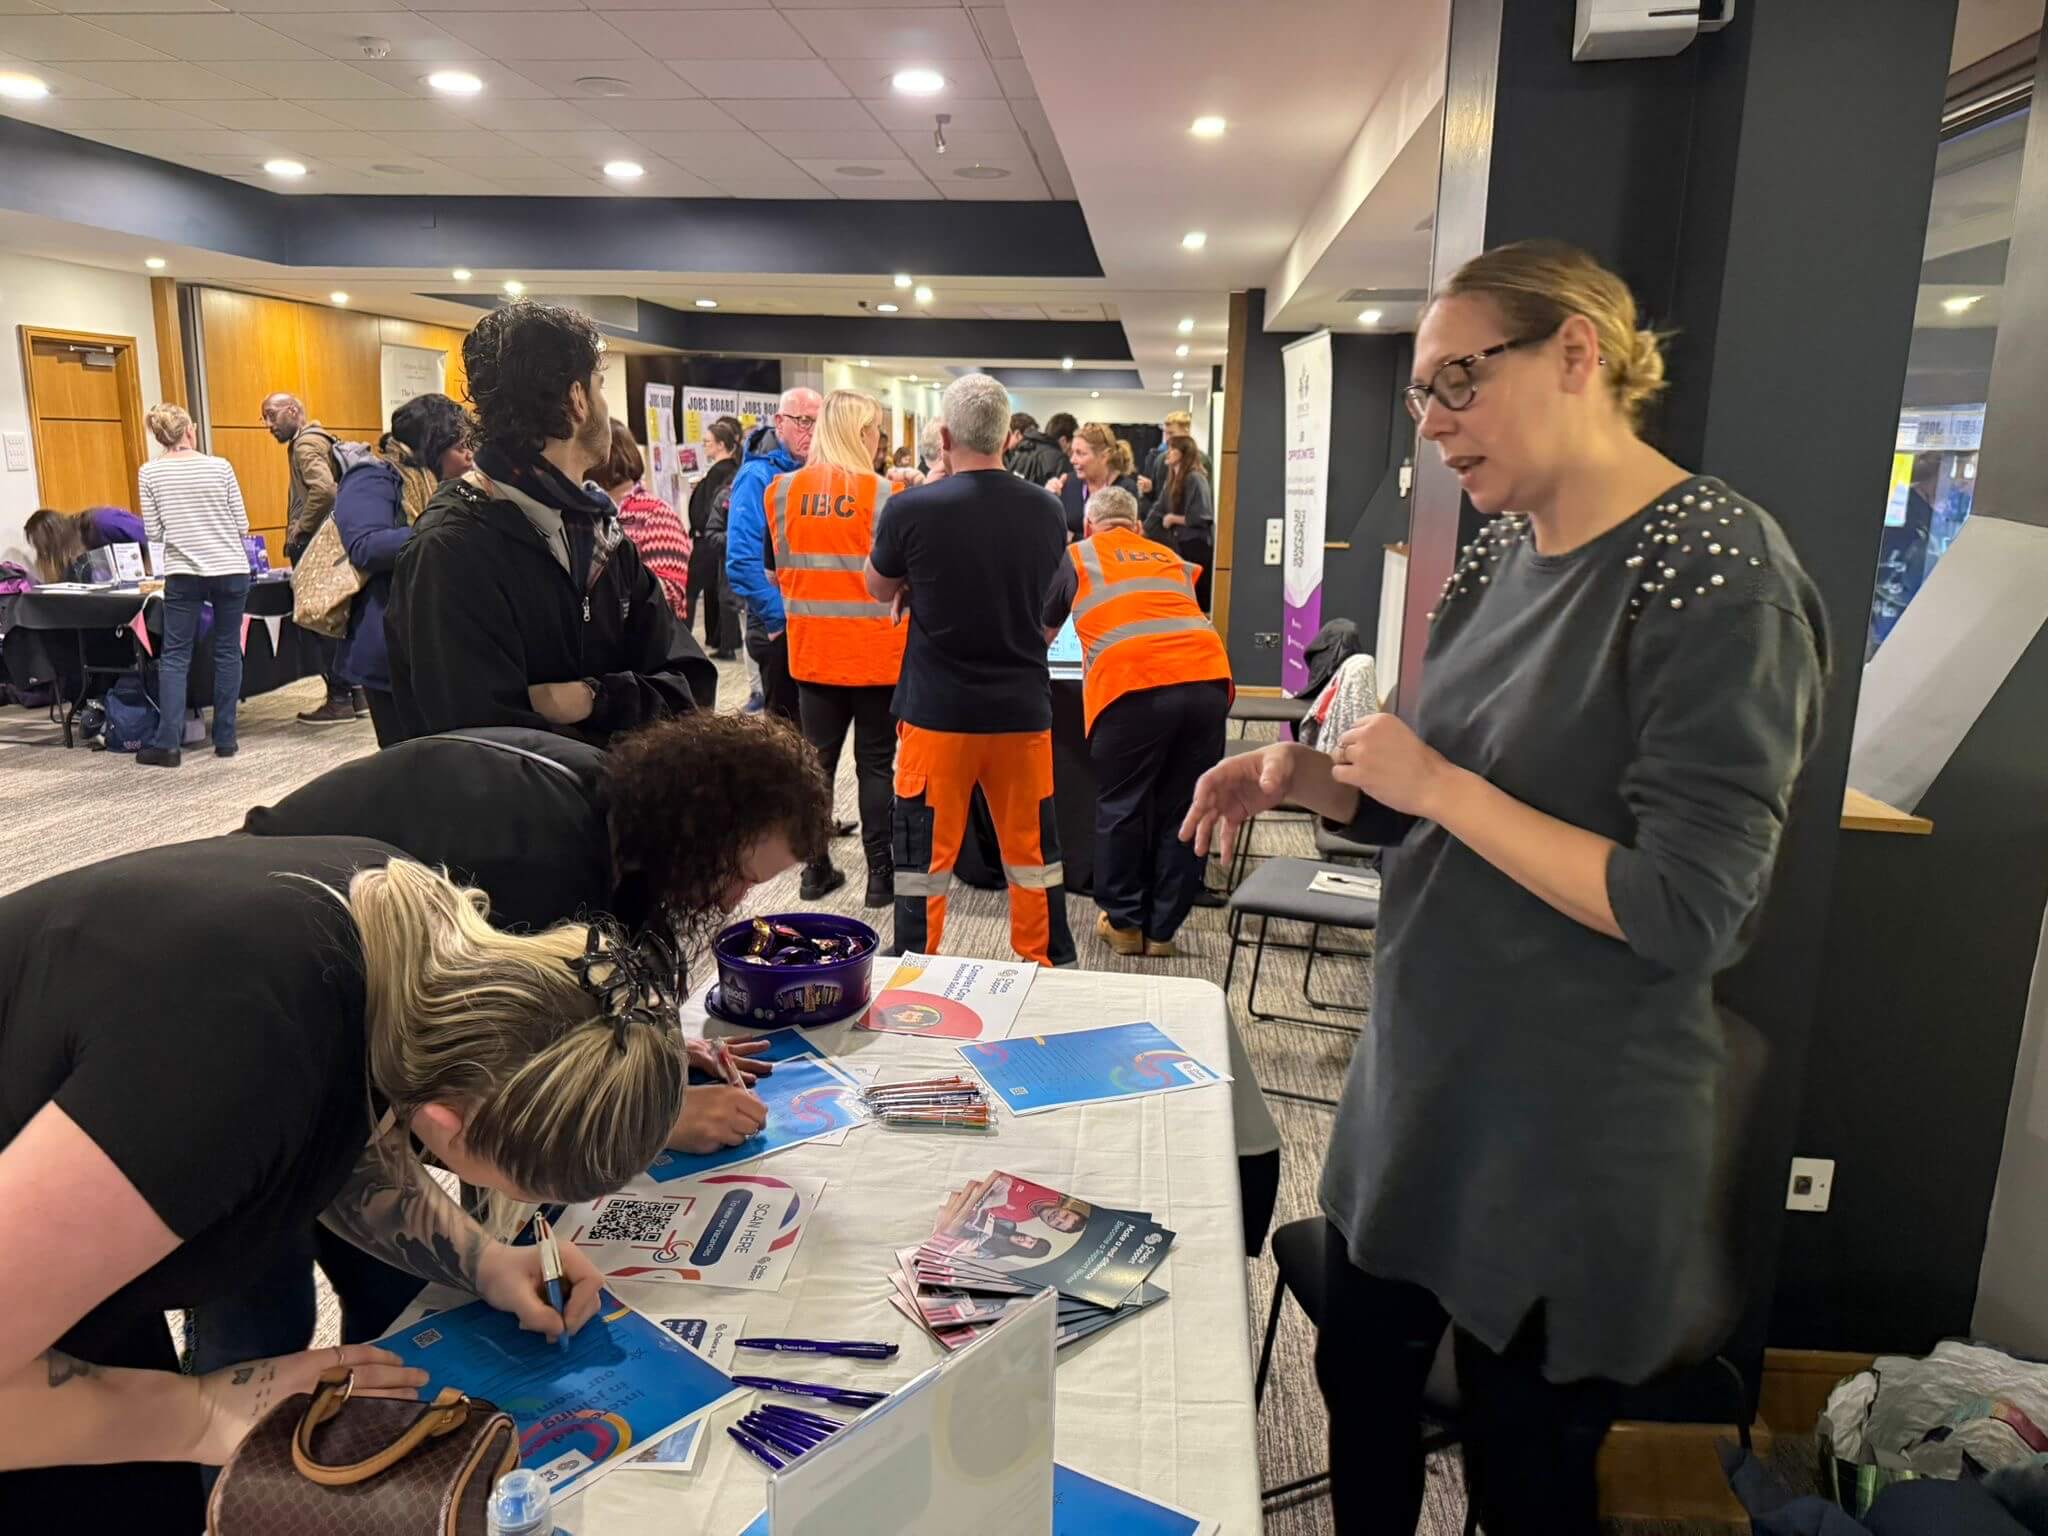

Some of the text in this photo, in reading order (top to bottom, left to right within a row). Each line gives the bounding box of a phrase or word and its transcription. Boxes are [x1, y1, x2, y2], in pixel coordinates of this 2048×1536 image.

[688, 397, 736, 413] JOBS BOARD
[742, 401, 762, 415] JOBS
[800, 494, 855, 518] IBC
[1114, 548, 1171, 564] IBC
[963, 964, 984, 988] Complex
[718, 1219, 728, 1231] our
[734, 1203, 770, 1254] SCAN HERE
[1119, 1224, 1136, 1242] Make
[702, 1229, 720, 1257] vacancies
[588, 1370, 615, 1388] our
